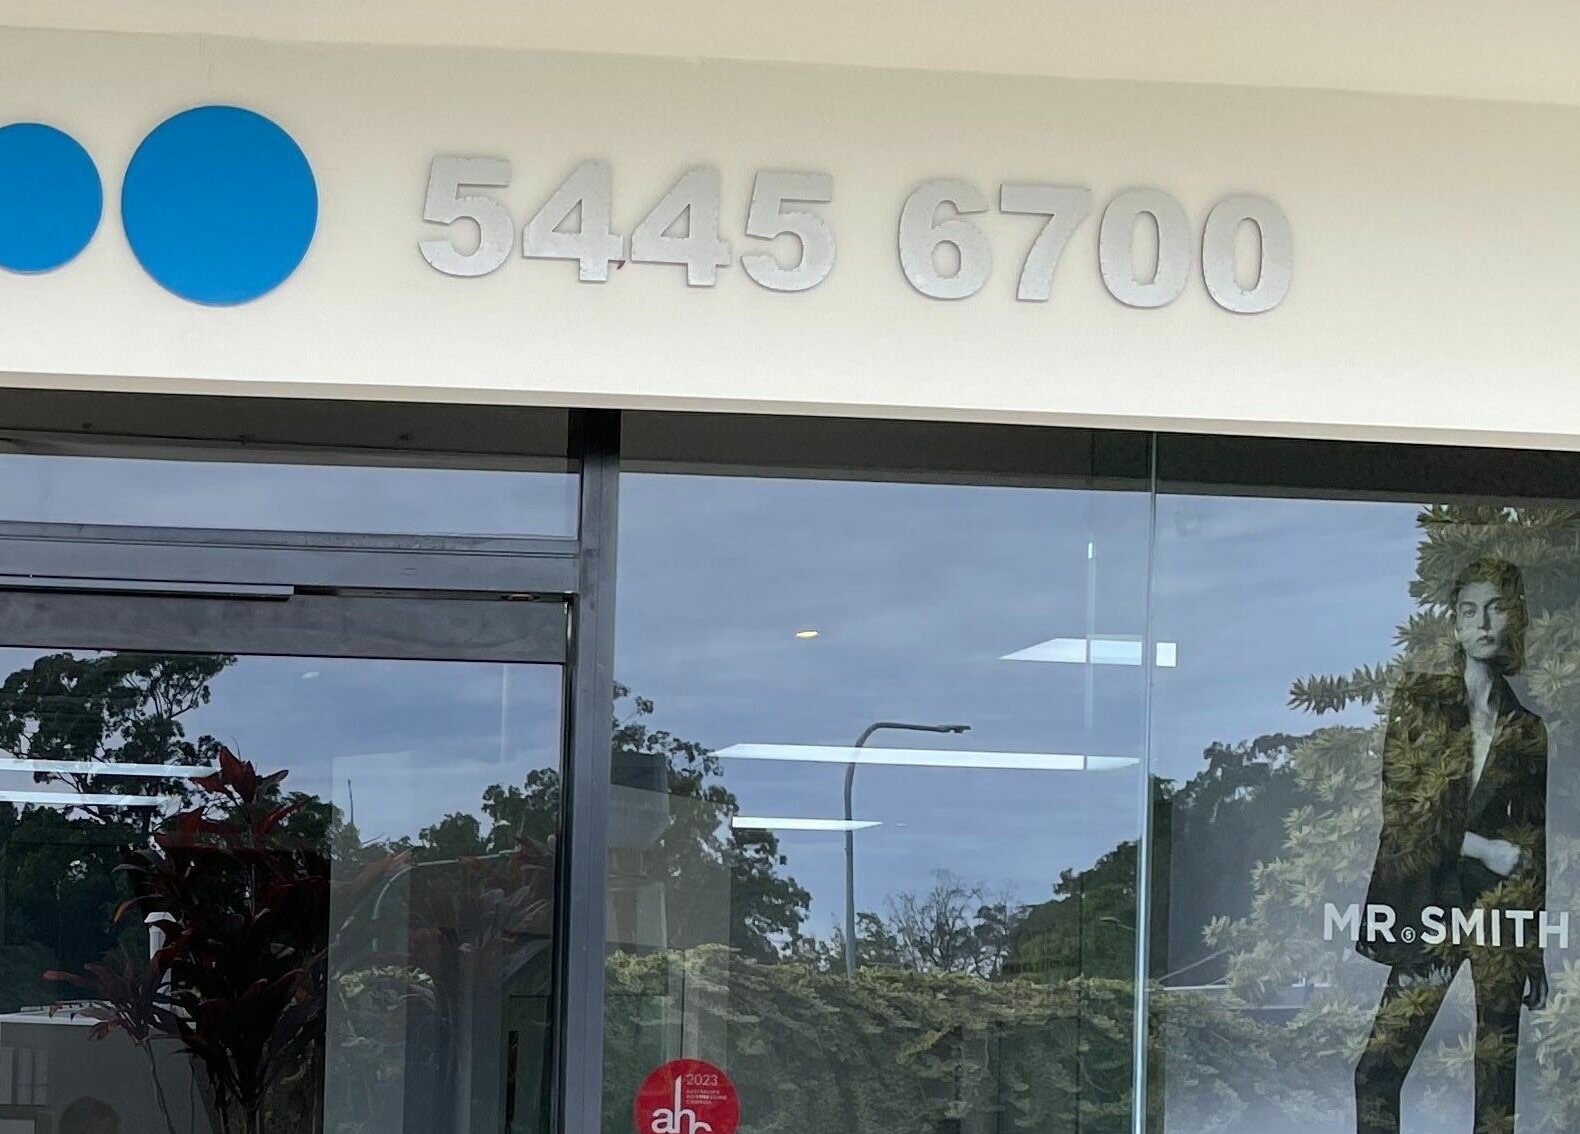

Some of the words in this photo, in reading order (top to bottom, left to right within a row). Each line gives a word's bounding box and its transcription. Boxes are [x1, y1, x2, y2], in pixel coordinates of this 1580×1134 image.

[417, 154, 837, 292] 5445
[896, 177, 1294, 315] 6700
[1420, 905, 1569, 949] SMITH
[685, 1073, 719, 1087] 2023
